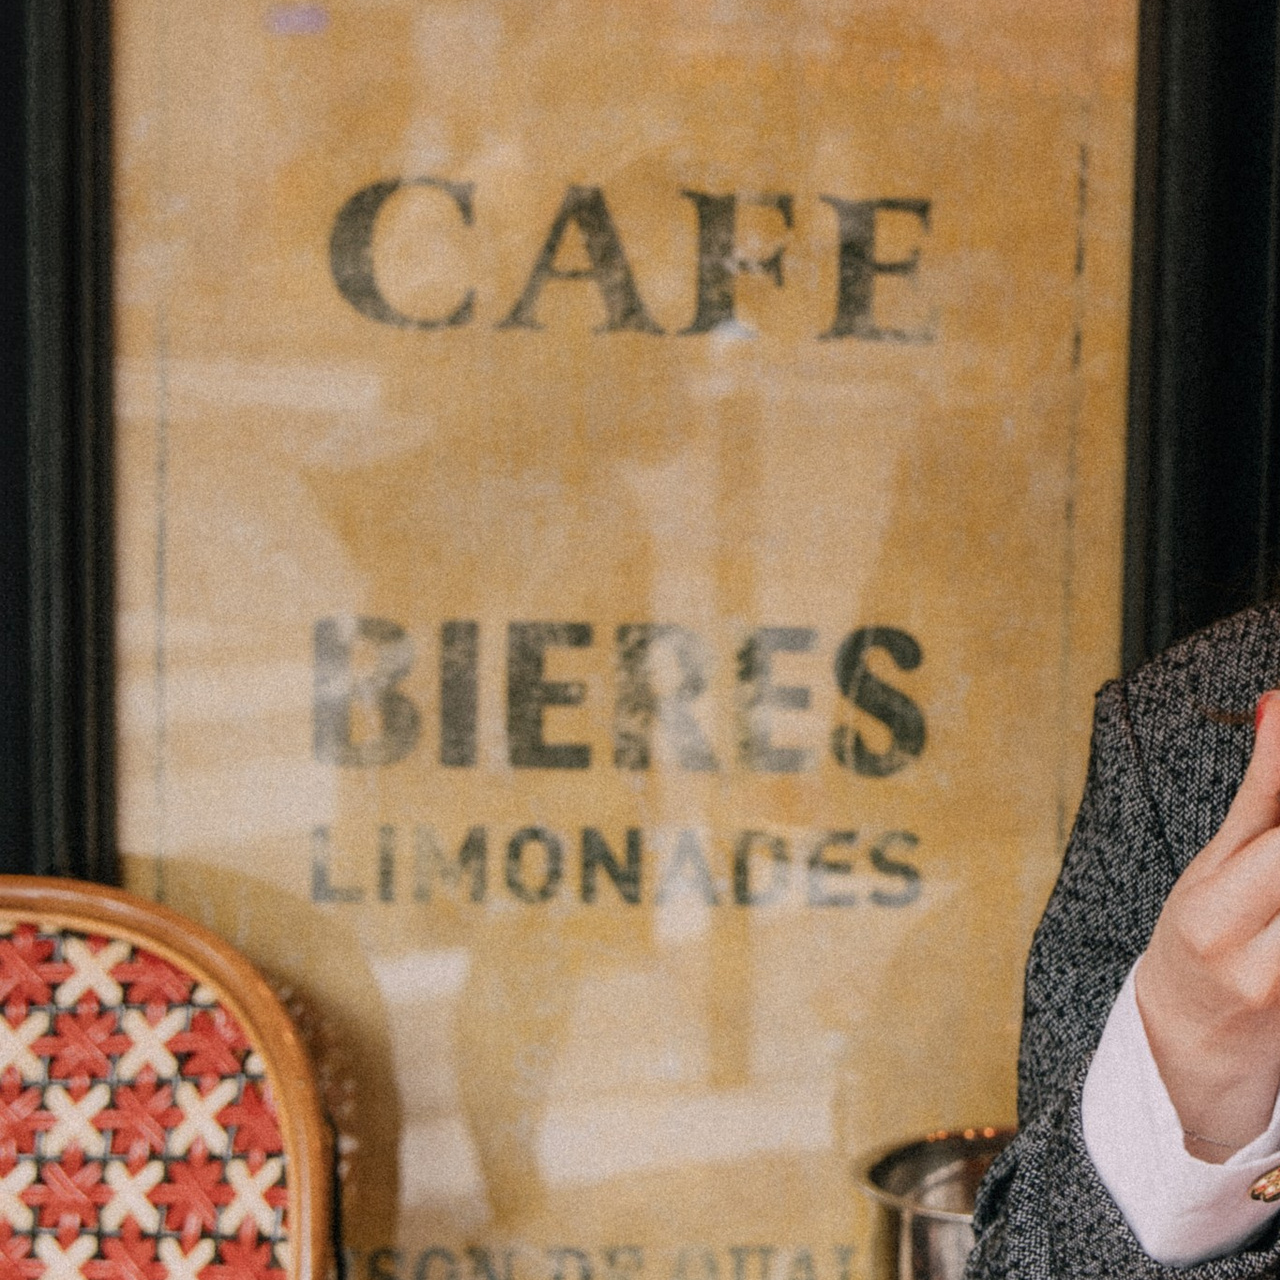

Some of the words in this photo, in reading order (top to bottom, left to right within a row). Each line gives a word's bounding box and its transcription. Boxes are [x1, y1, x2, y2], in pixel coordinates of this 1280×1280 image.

[327, 176, 937, 344] CAFE
[312, 616, 929, 777] BIERES
[311, 824, 923, 908] LIMONADES
